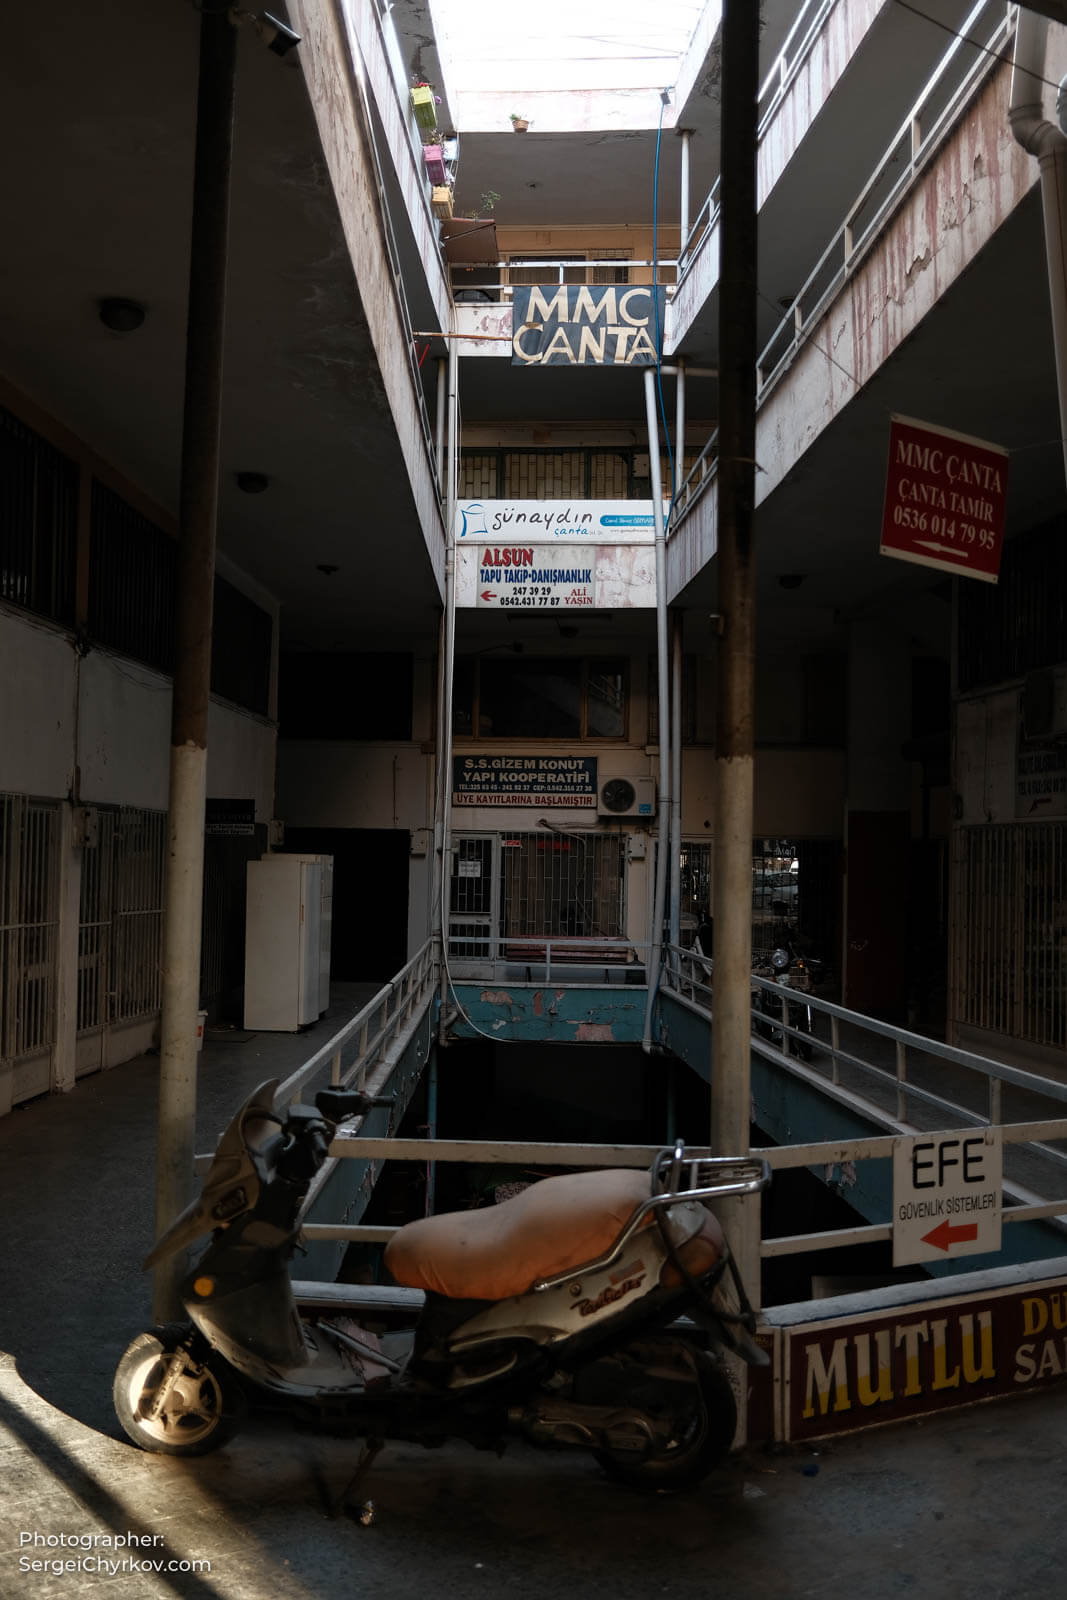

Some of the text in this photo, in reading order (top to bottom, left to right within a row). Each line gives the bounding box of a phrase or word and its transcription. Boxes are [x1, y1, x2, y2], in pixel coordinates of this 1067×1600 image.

[513, 322, 658, 365] ÇANTA
[895, 440, 1003, 495] MMC ÇANTA
[897, 478, 994, 523] ÇANTA TAMİR
[492, 507, 592, 530] günaydın
[893, 505, 997, 551] 0536 014 79 95
[554, 526, 589, 536] çanta
[482, 548, 534, 567] ALSUN
[480, 569, 502, 583] TAPU
[513, 587, 551, 595] 247 39 29
[571, 587, 587, 596] ALİ
[500, 597, 560, 606] 0542.431 77 87
[538, 760, 584, 770] KONUT
[463, 771, 590, 783] YAPI KOOPERATİFİ
[457, 794, 593, 805] ÜYE KAYITLARINA BAŞLAMIŞTIR
[913, 1138, 985, 1188] EFE
[900, 1192, 996, 1220] GÜVENLİK SİSTEMLERİ
[802, 1311, 996, 1418] MUTLU
